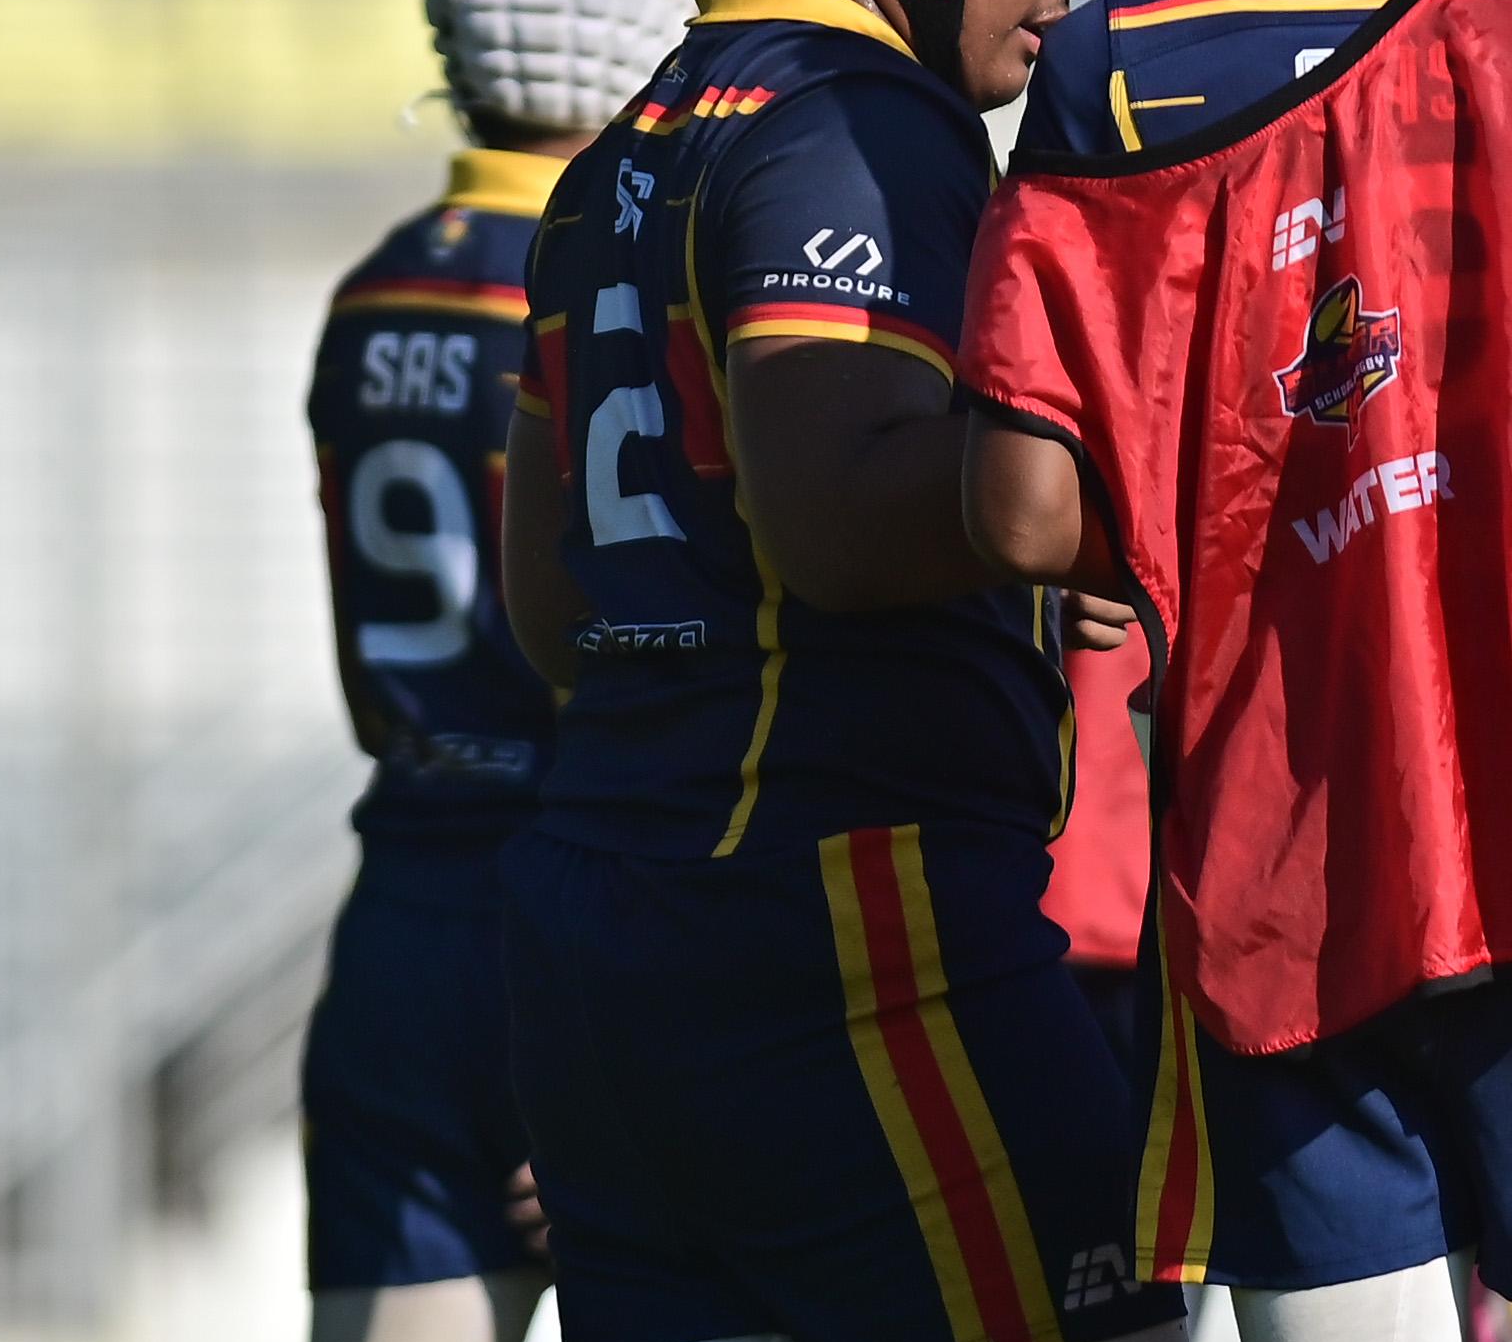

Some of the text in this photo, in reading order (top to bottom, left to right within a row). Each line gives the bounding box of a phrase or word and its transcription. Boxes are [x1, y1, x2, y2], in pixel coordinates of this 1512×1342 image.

[762, 273, 911, 306] PIROQURE
[358, 332, 477, 409] SAS
[350, 440, 478, 663] 9
[1291, 450, 1455, 565] WATER
